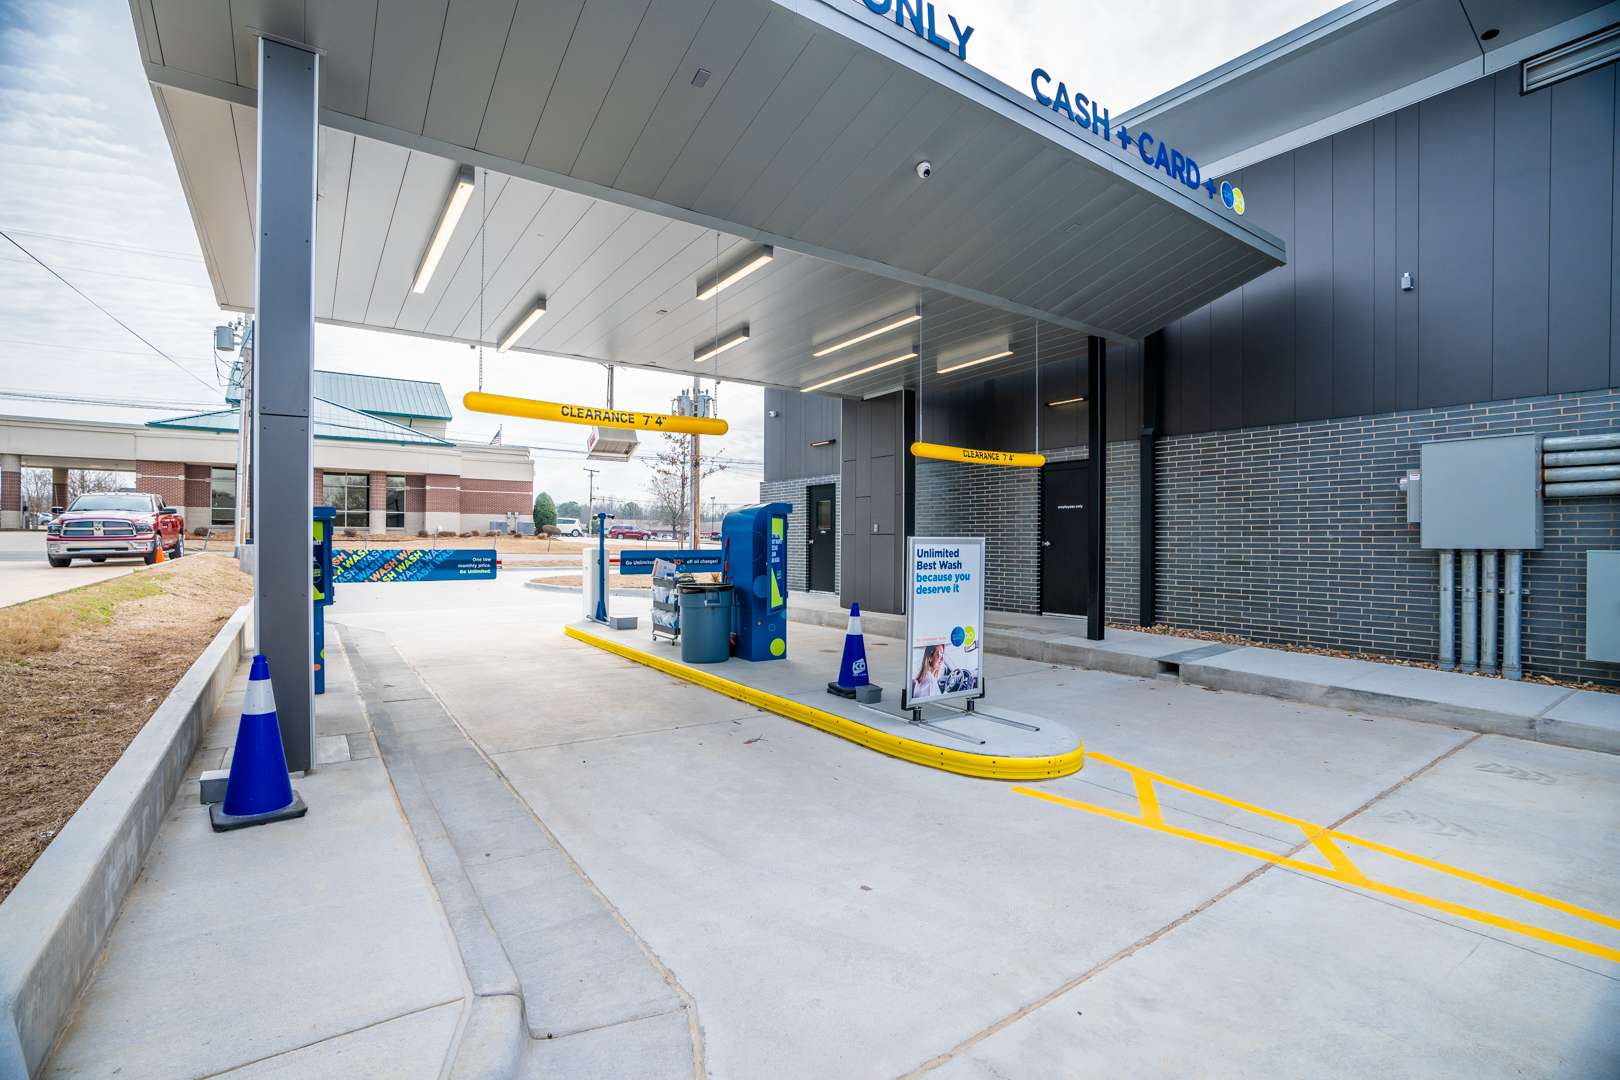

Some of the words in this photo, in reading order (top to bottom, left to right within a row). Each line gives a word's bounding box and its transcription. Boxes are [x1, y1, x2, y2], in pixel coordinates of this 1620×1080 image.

[1031, 68, 1111, 142] CASH
[1138, 131, 1201, 190] CARD
[561, 405, 635, 424] CLEARANCE
[962, 450, 1000, 461] CLEARANCE
[917, 548, 960, 558] Unlimited
[395, 550, 424, 573] WASH
[916, 560, 937, 570] Best
[939, 560, 962, 570] Wash
[369, 558, 398, 582] WASH
[916, 572, 953, 583] because
[954, 572, 970, 583] you
[915, 584, 951, 594] deserve
[953, 583, 960, 593] it
